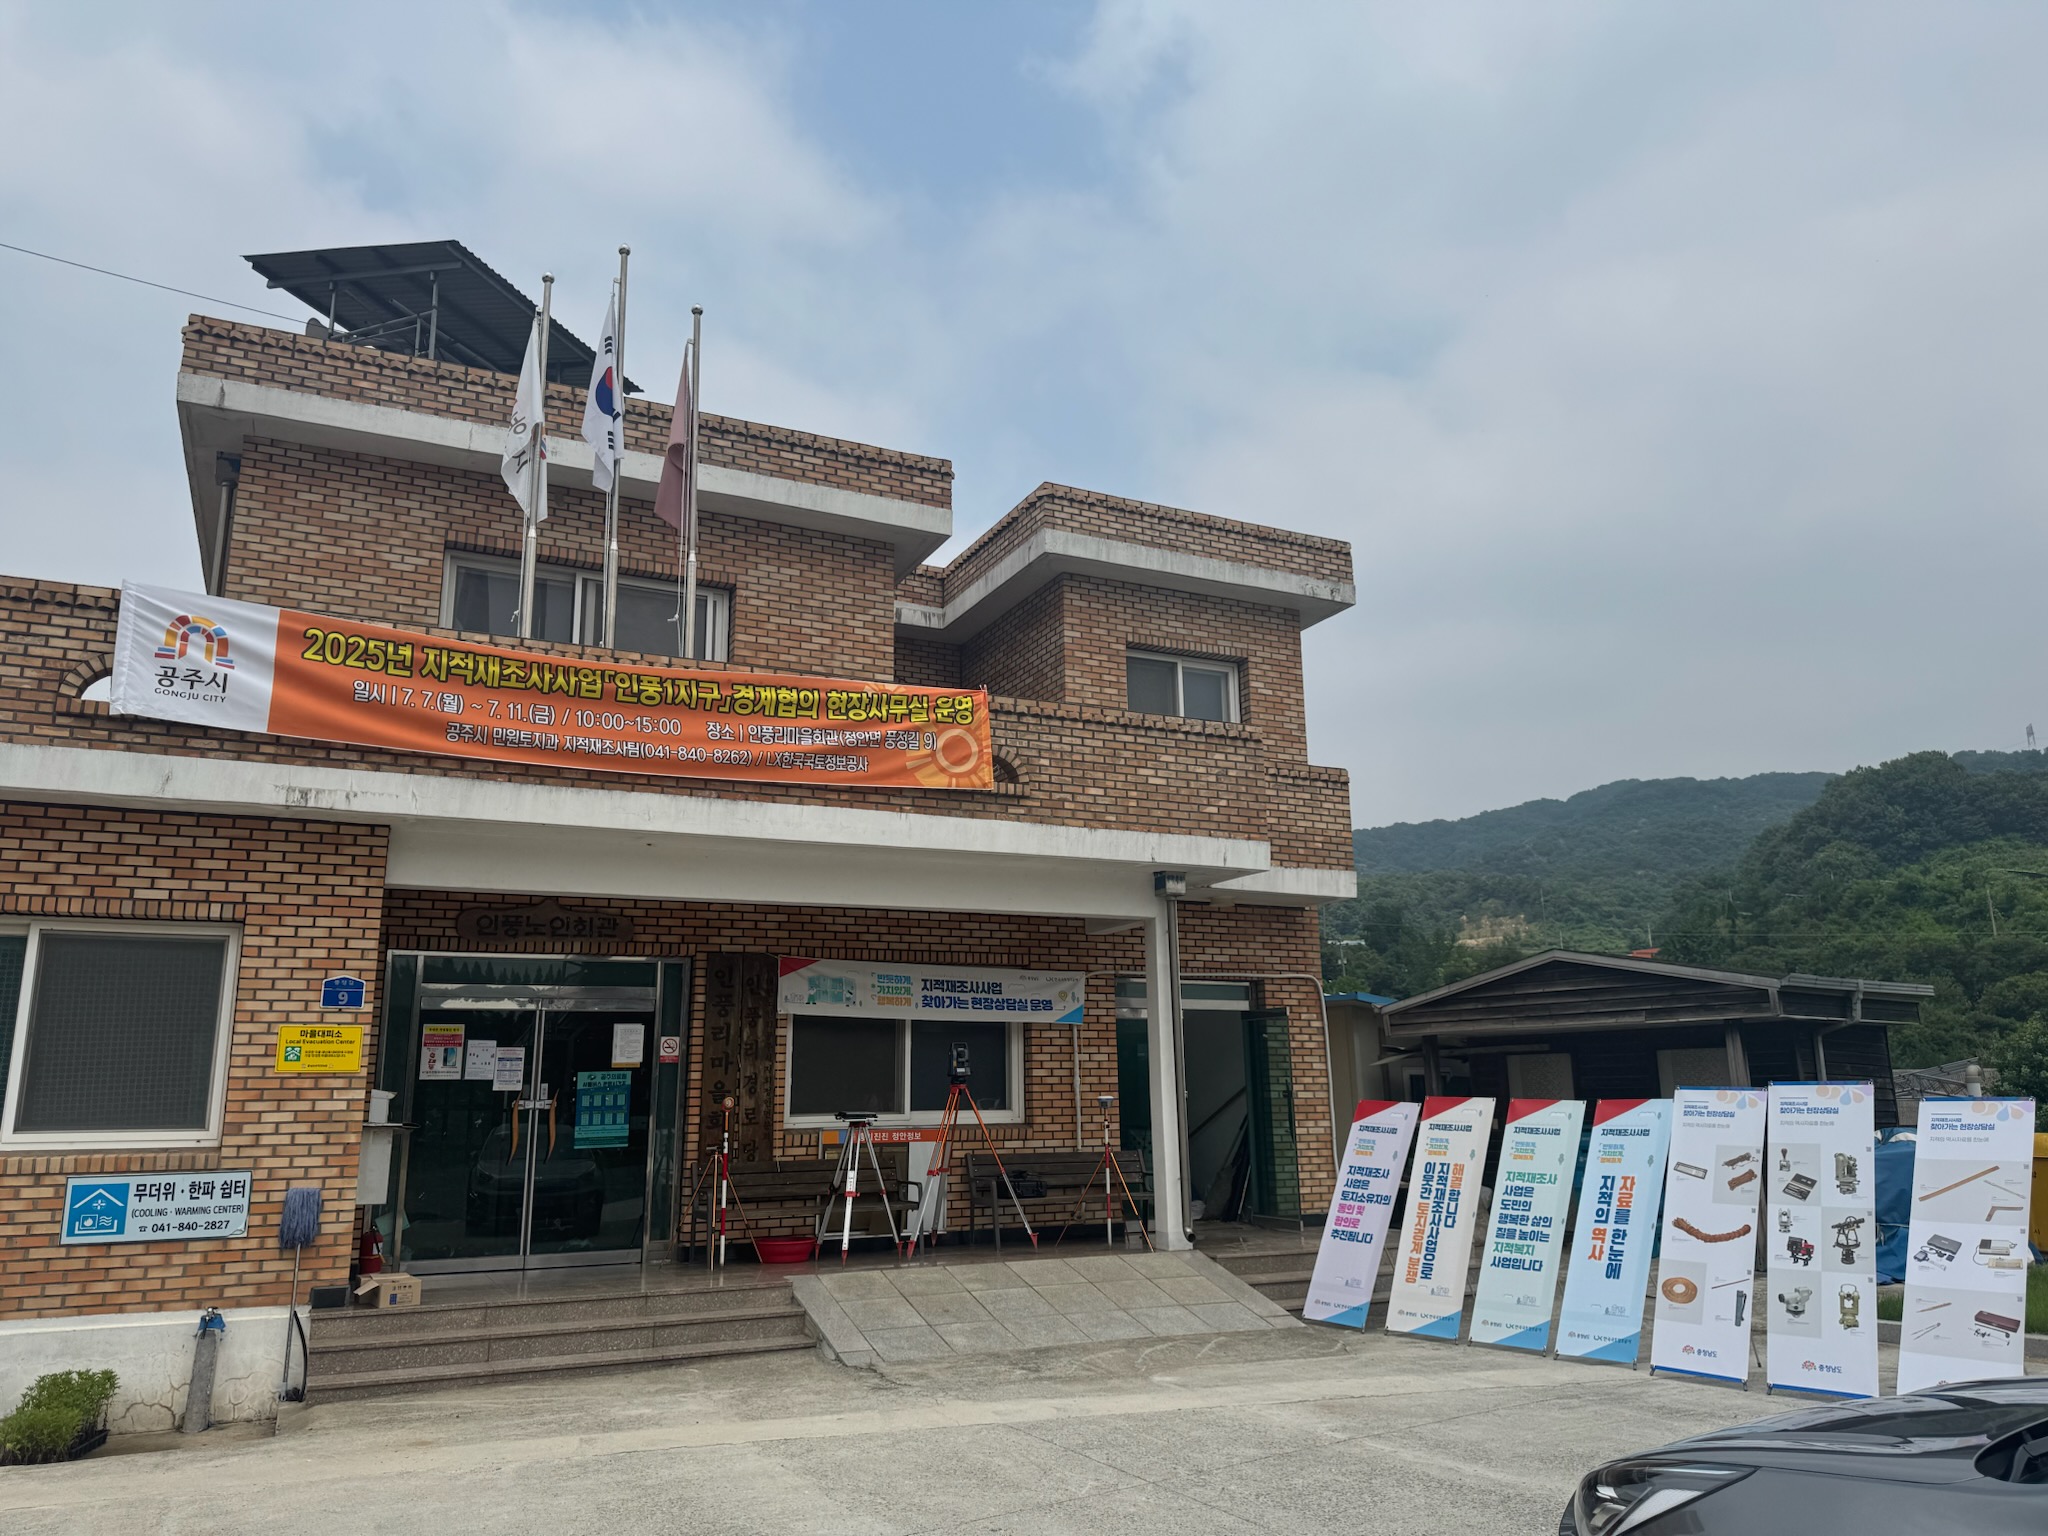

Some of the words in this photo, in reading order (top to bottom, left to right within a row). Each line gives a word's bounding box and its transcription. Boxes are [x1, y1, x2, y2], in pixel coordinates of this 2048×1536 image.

[154, 665, 229, 694] 공주시
[301, 627, 417, 679] 2025년
[826, 689, 931, 724] 현장사무실
[934, 694, 975, 725] 운영
[154, 687, 200, 702] GONGJU
[202, 693, 228, 704] CITY
[352, 680, 387, 706] 일시
[574, 708, 682, 737] 10:00~15:00
[705, 721, 736, 741] 장소
[747, 724, 881, 750] 인풍리마을회관(정안면
[884, 730, 921, 751] 풍정길
[923, 731, 938, 751] 9)
[446, 721, 489, 745] 공주시
[492, 727, 560, 752] 민원토지과
[562, 735, 753, 767] 지적재조사팀(041-840-8262)
[765, 751, 869, 773] LX한국국토정보공사
[476, 913, 619, 939] 인풍노인회관
[921, 978, 1002, 996] 지적재조사사업
[338, 991, 349, 1005] 9
[921, 994, 970, 1010] 찾아가는
[970, 996, 1029, 1012] 현장상담실
[1029, 998, 1054, 1012] 운영
[300, 1029, 343, 1039] 마을대피소
[705, 966, 735, 1155] 인풍리마을회
[743, 975, 762, 1163] 인풍리경로당
[1358, 1125, 1398, 1135] 지적재조사사업
[1428, 1123, 1472, 1132] 지적재조사사업
[1513, 1126, 1561, 1136] 지적재조사사업
[1601, 1128, 1650, 1137] 지적재조사사업
[1959, 1123, 1995, 1131] 현장상담실
[891, 1131, 922, 1141] 정안정보
[1346, 1165, 1390, 1179] 지적재조사
[1504, 1170, 1558, 1185] 지적재조사
[133, 1181, 176, 1203] 무더위
[188, 1180, 217, 1201] 한파
[220, 1179, 247, 1200] 쉼터
[1343, 1178, 1370, 1190] 사업은
[1502, 1184, 1535, 1198] 사업은
[1340, 1190, 1392, 1205] 토지소유자의
[1443, 1162, 1465, 1229] 해결합니다
[1594, 1175, 1616, 1224] 지적의
[1613, 1175, 1637, 1225] 자료를
[131, 1208, 169, 1219] (COOLING
[174, 1205, 212, 1217] WARMING
[213, 1203, 245, 1215] CENTER)
[1499, 1198, 1533, 1212] 도민의
[151, 1220, 231, 1233] 041-840-2827
[1420, 1162, 1451, 1280] 지적재조사사업으로
[1497, 1212, 1530, 1227] 행복한
[1530, 1215, 1553, 1229] 삶의
[1330, 1228, 1374, 1244] 추진됩니다
[1495, 1227, 1517, 1240] 질을
[1518, 1228, 1551, 1243] 높이는
[1492, 1241, 1535, 1256] 지적복지
[1587, 1227, 1607, 1261] 역사
[1605, 1228, 1628, 1280] 한눈에
[1490, 1255, 1544, 1272] 사업입니다
